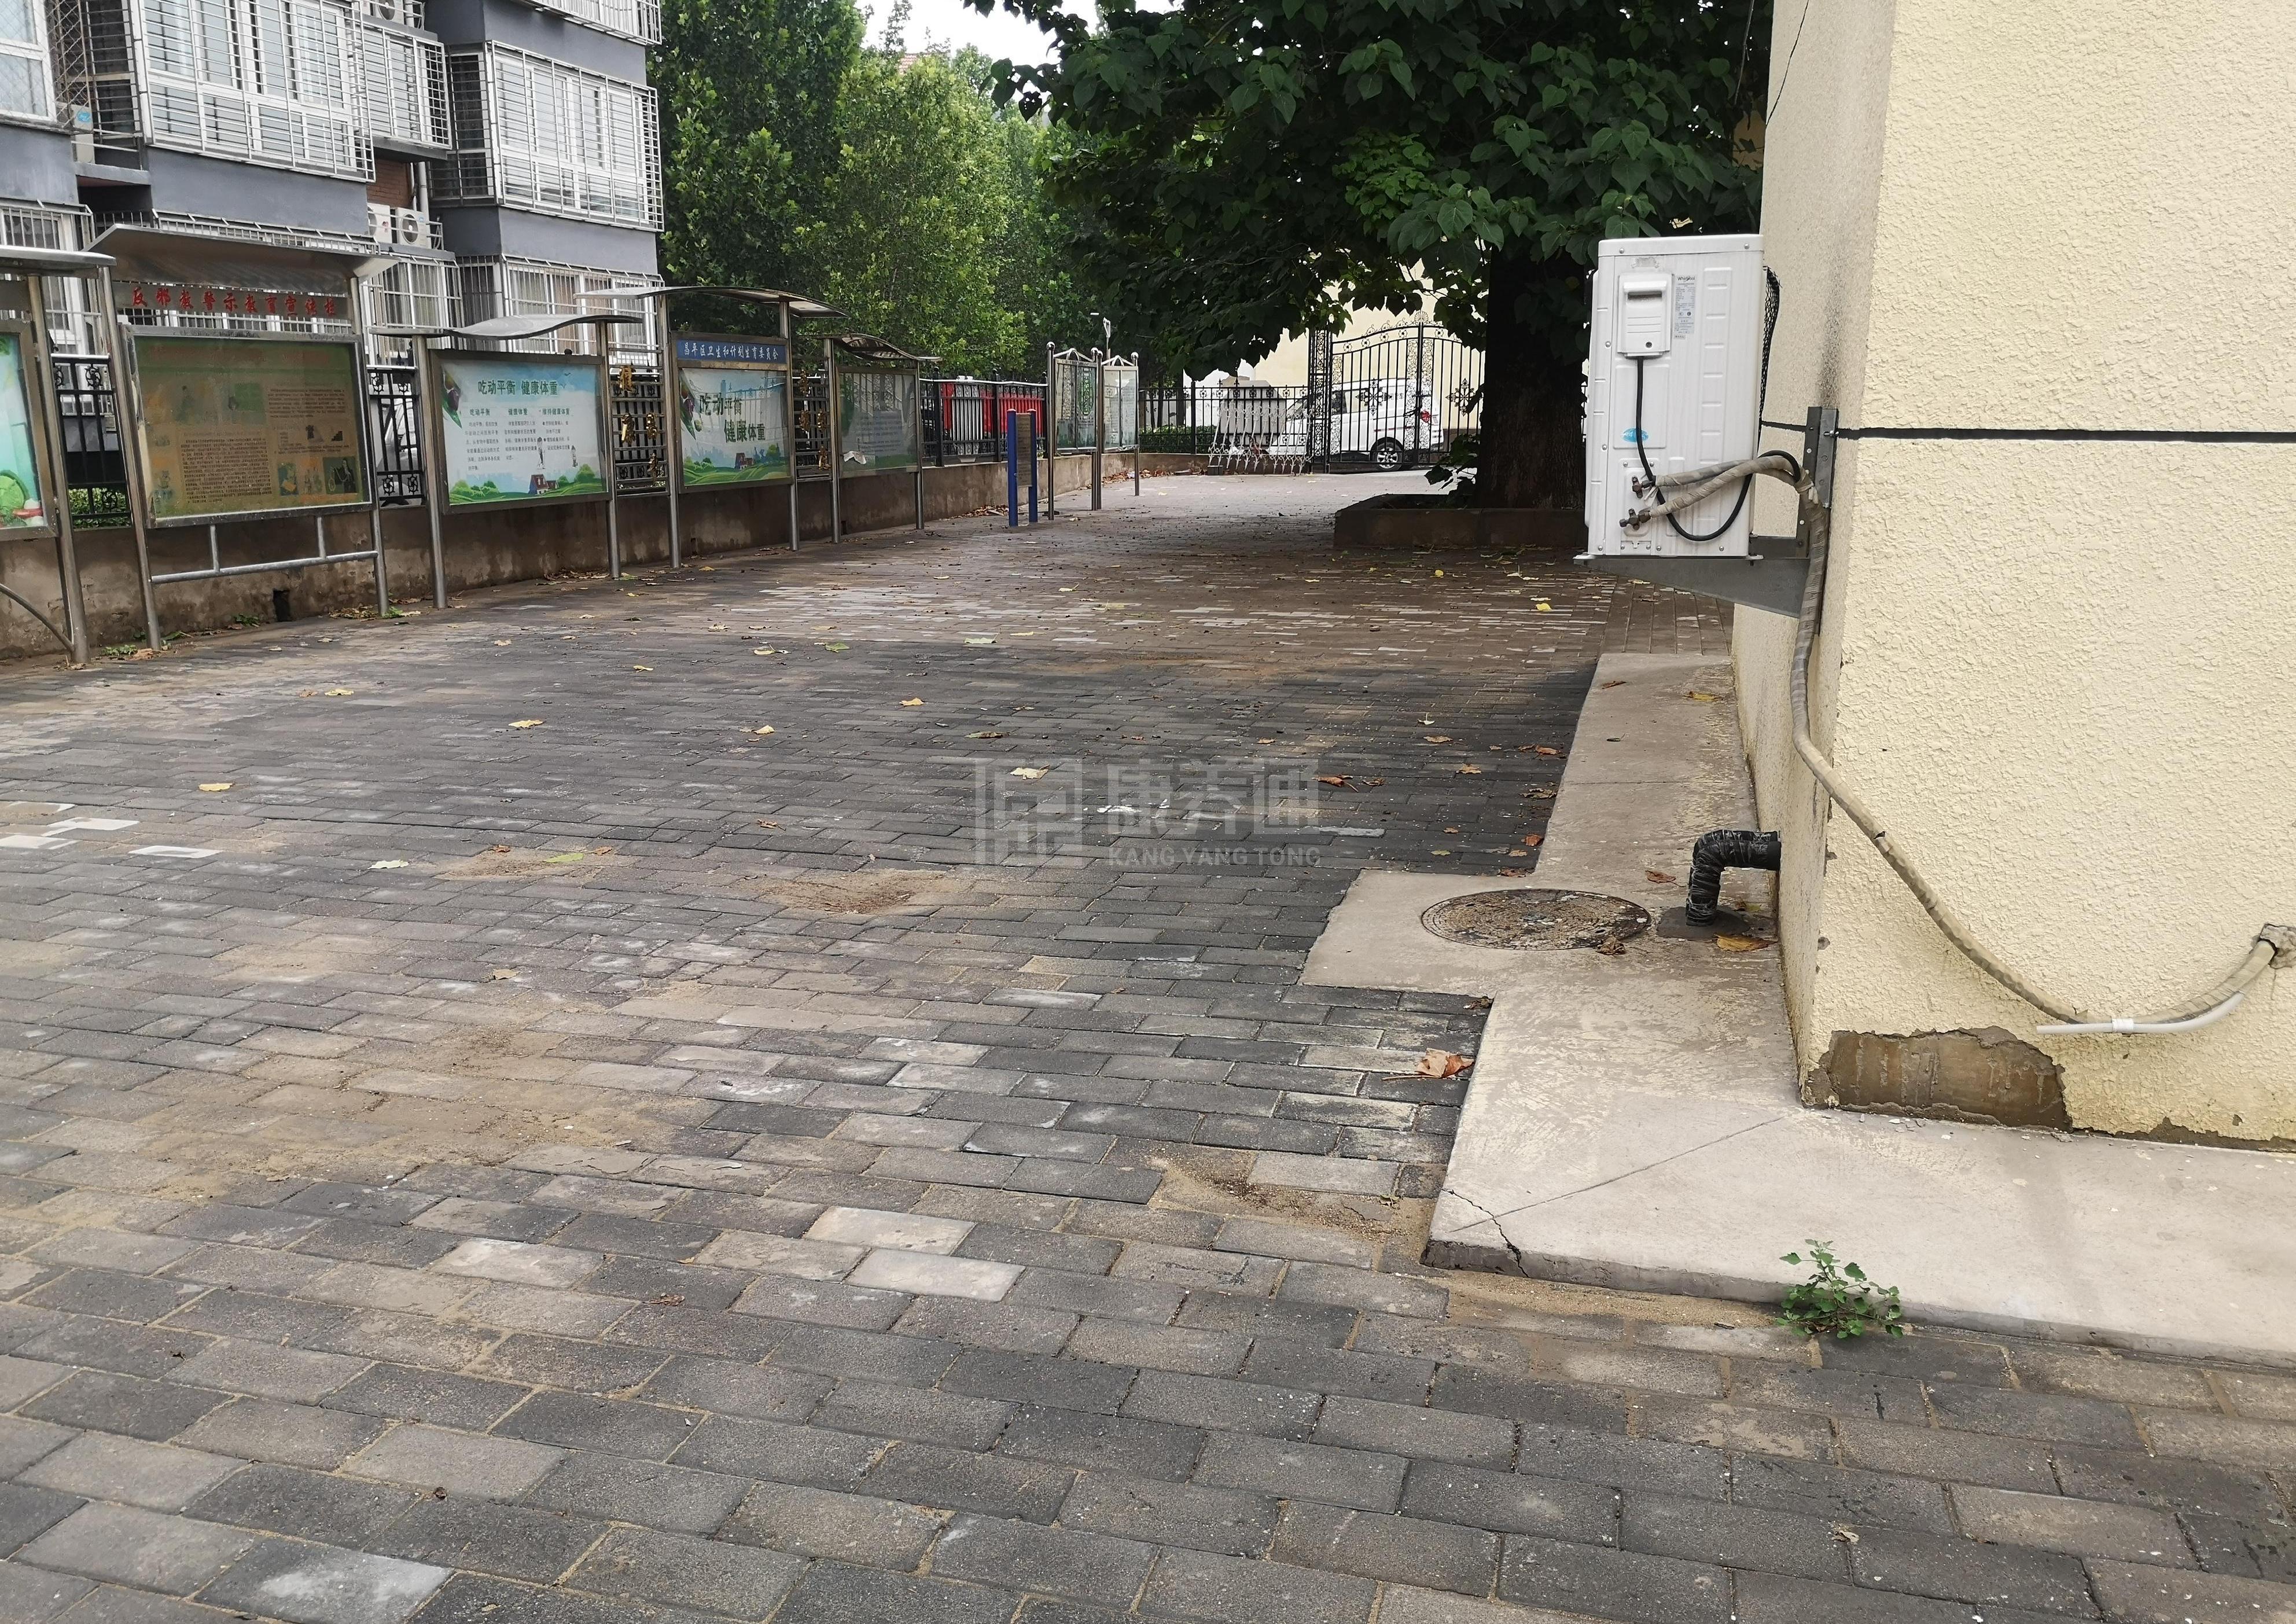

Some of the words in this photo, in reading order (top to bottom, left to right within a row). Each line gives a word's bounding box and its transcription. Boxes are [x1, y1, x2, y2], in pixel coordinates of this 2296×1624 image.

[684, 342, 779, 361] 昌平区卫生和计划生育委员会
[477, 379, 516, 395] 吃动平衡
[521, 380, 558, 396] 健康体重
[700, 392, 743, 416] 吃动平衡
[724, 419, 766, 443] 健康体重
